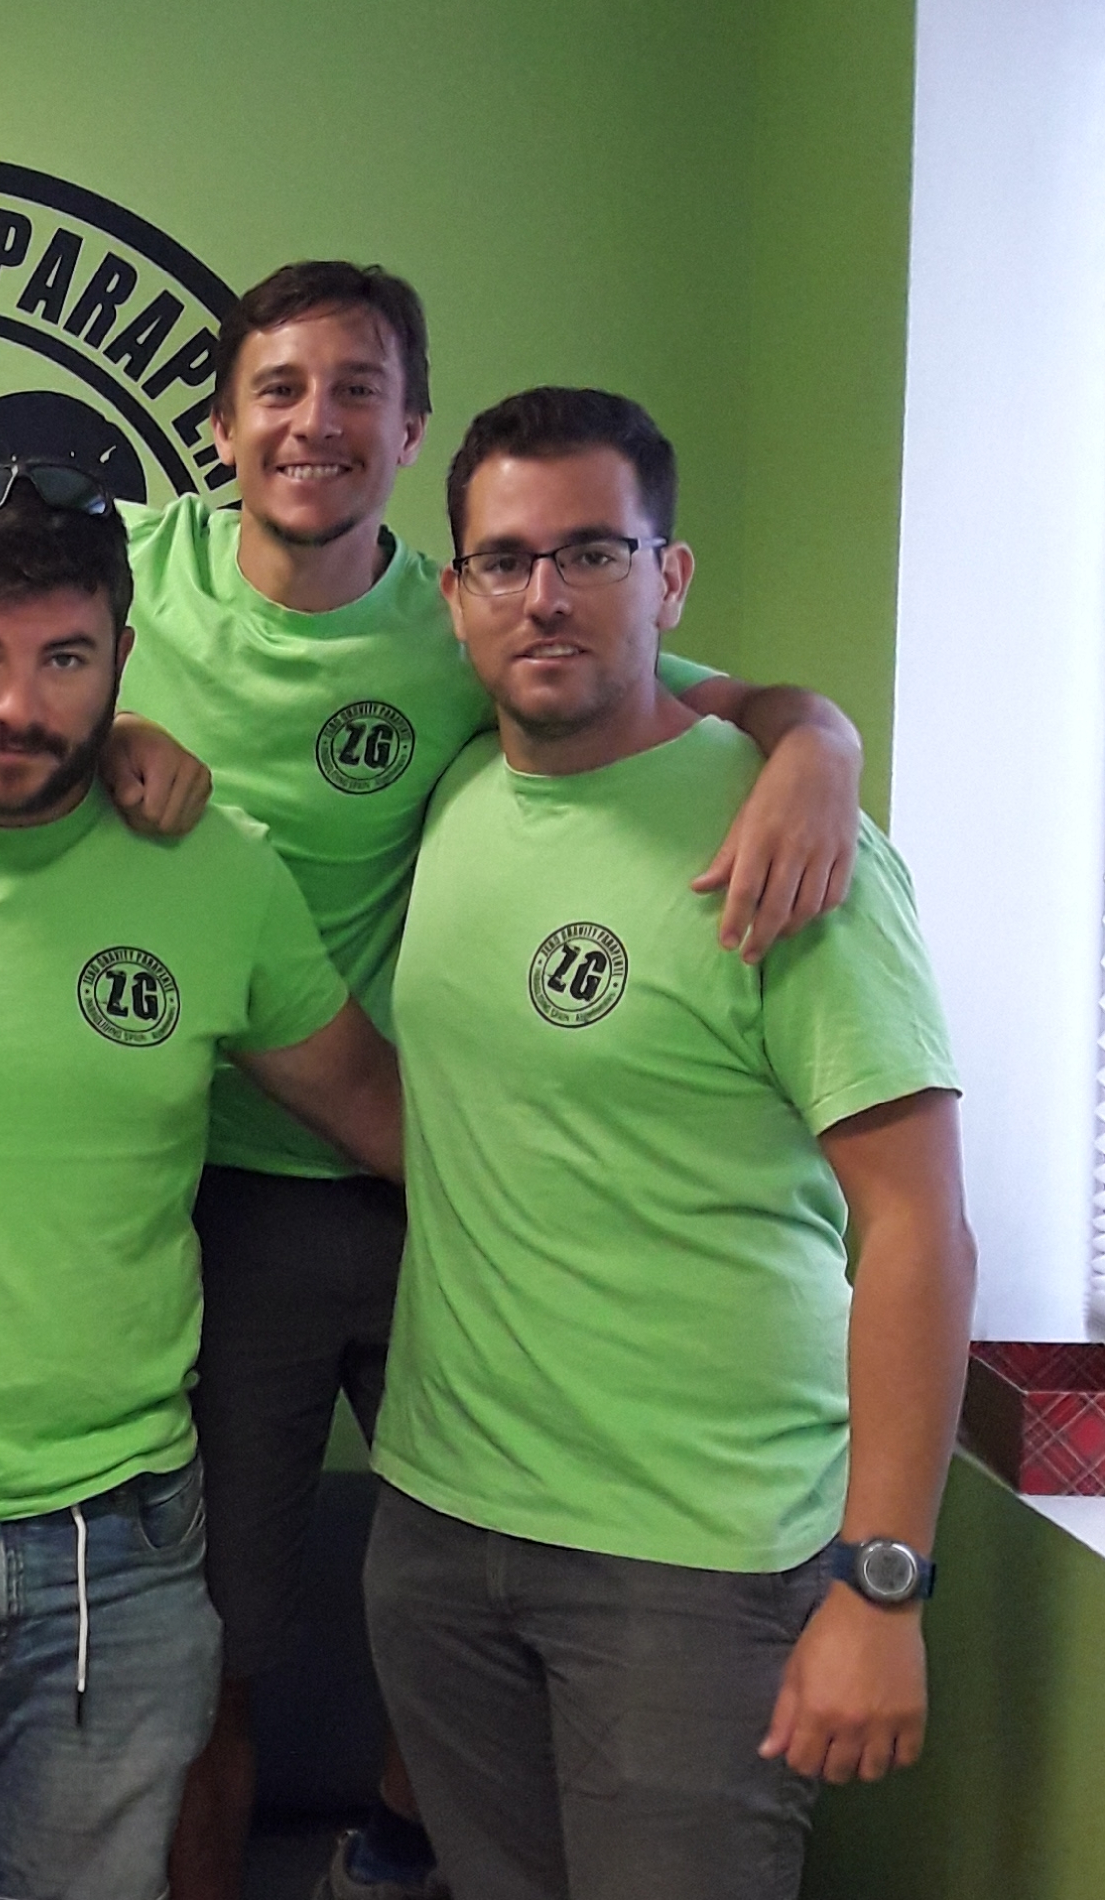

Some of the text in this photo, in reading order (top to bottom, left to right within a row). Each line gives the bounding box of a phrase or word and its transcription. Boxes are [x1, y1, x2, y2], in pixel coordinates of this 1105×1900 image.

[338, 722, 394, 770] ZG
[105, 969, 159, 1021] ZG
[547, 942, 608, 1002] ZG
